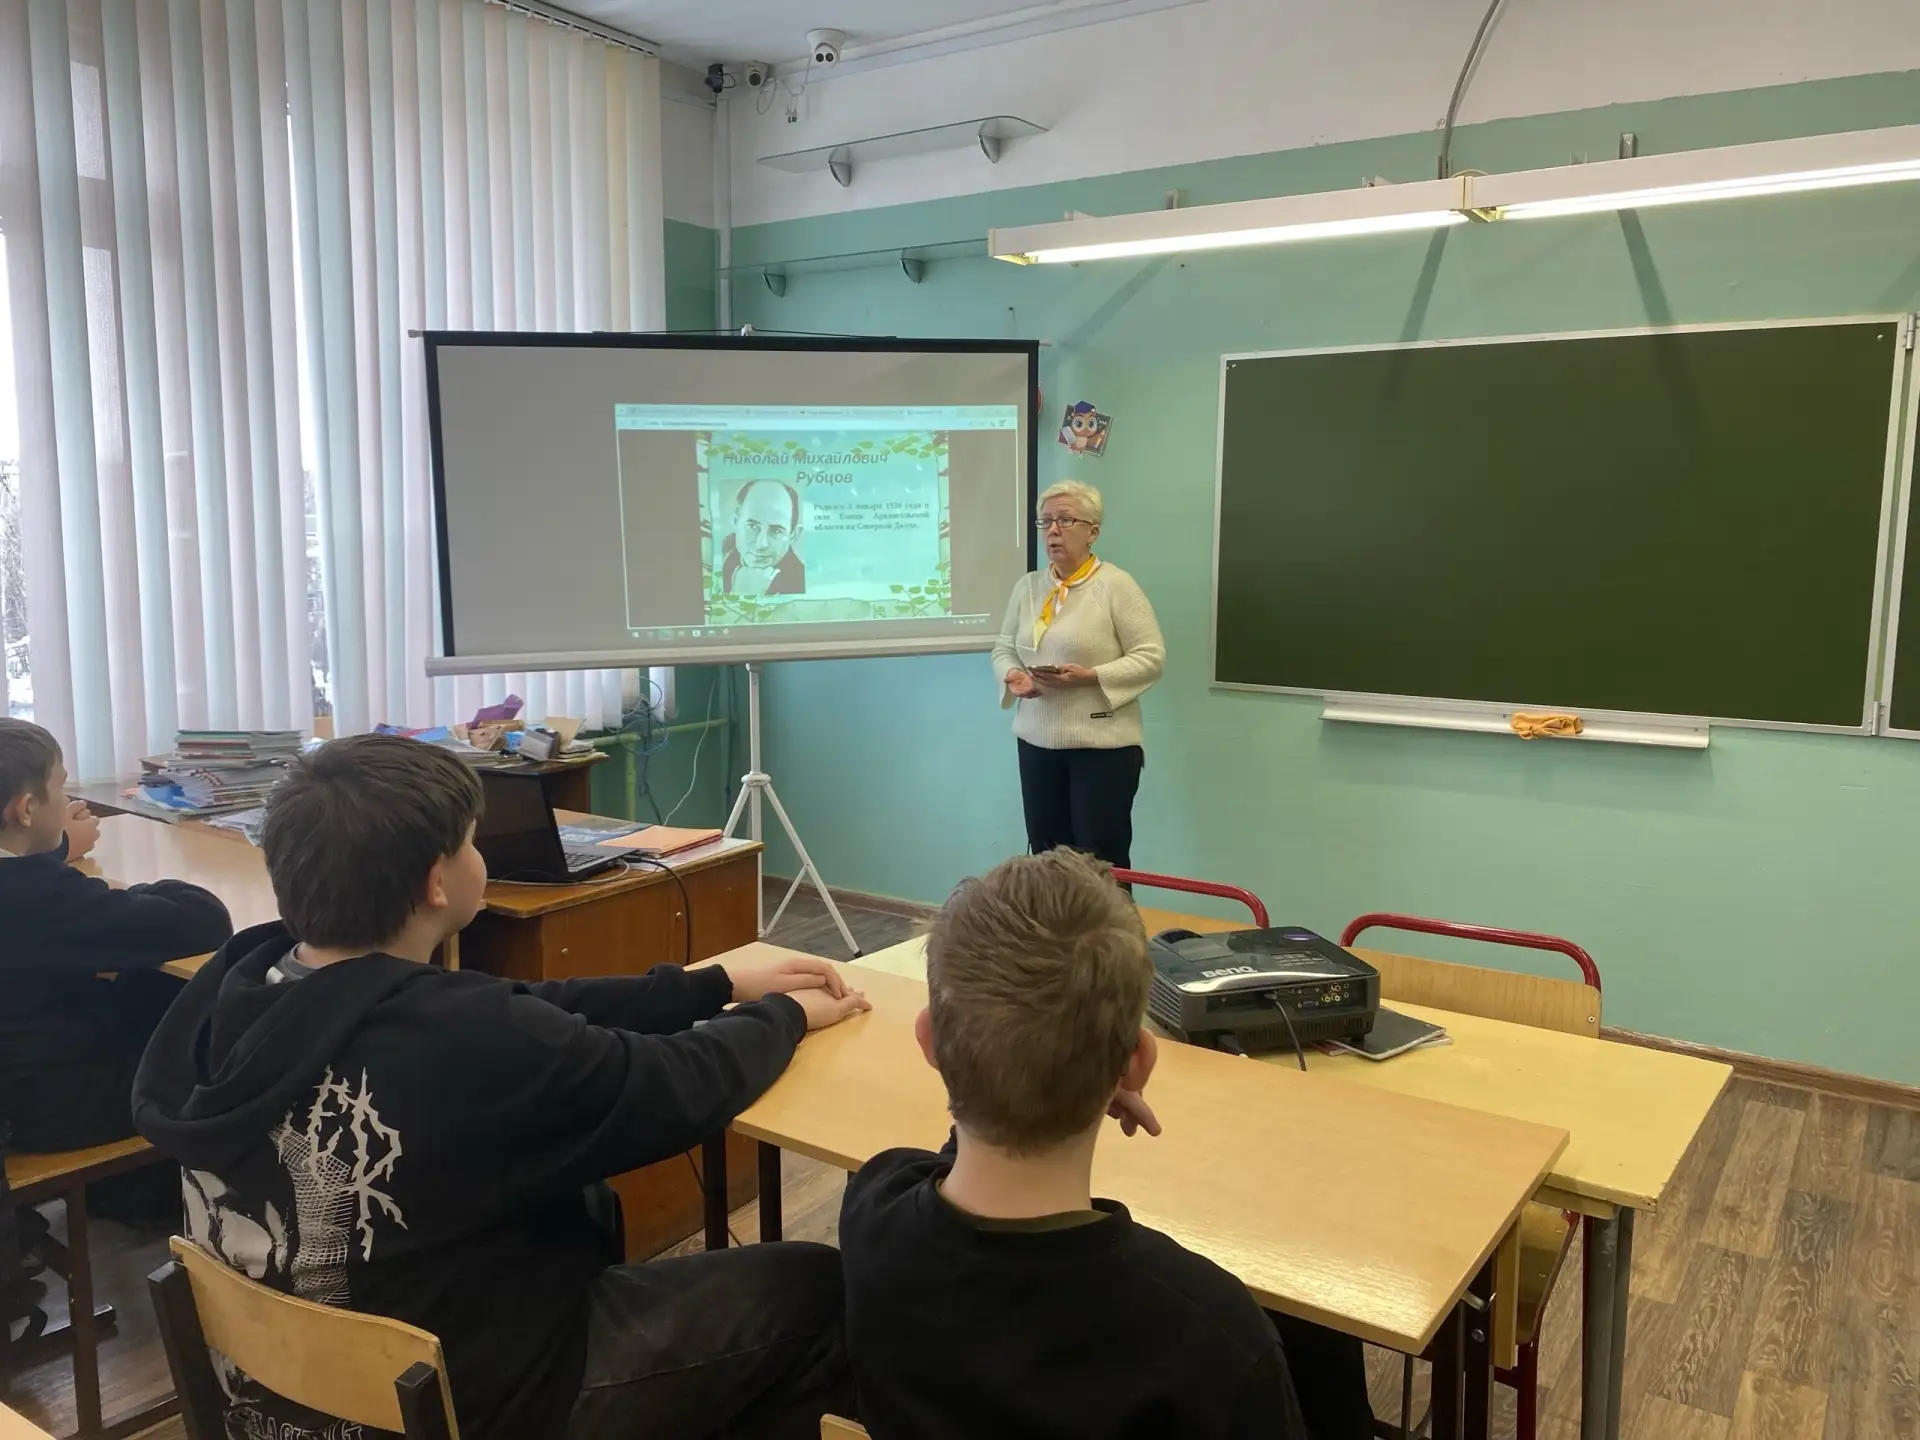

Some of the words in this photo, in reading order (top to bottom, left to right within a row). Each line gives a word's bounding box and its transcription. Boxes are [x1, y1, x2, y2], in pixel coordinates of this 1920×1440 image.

[723, 452, 788, 466] Николай
[794, 451, 888, 466] Михайлович
[796, 471, 853, 486] Рубцов
[1200, 966, 1258, 978] BenQ
